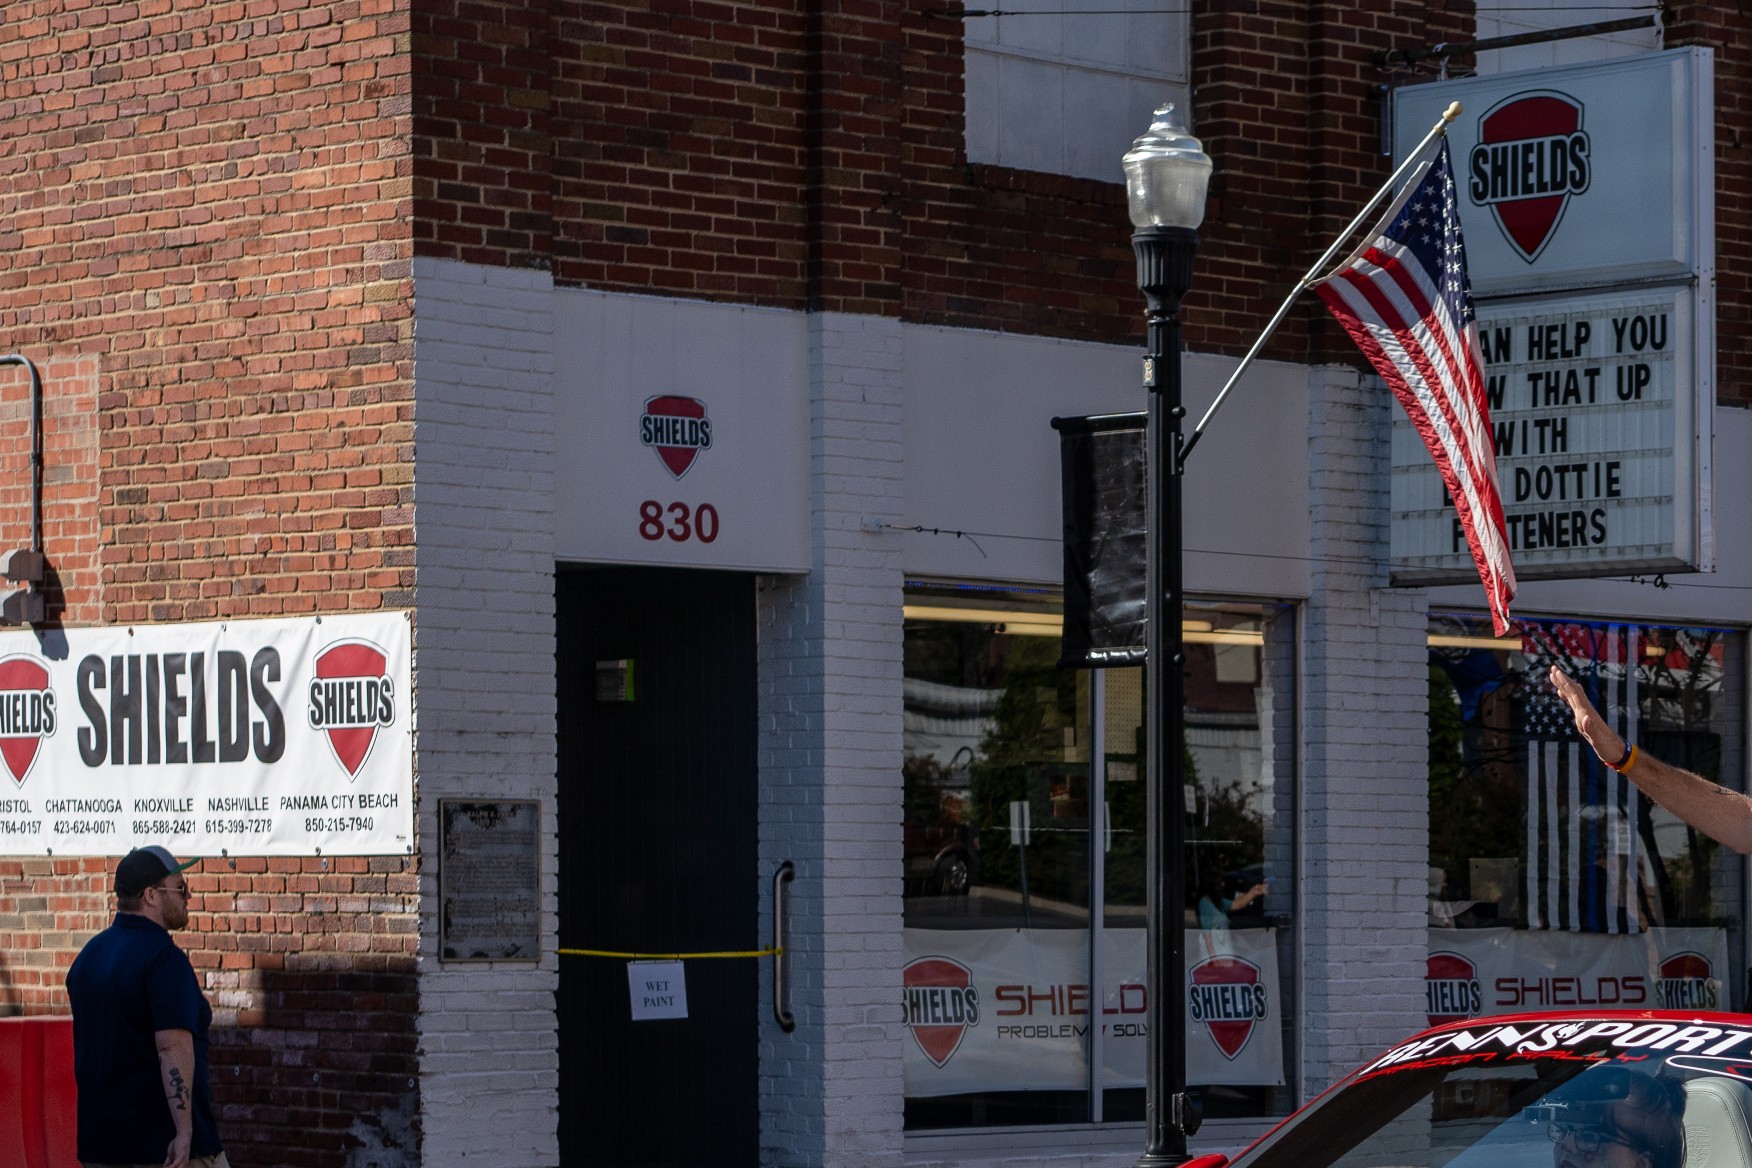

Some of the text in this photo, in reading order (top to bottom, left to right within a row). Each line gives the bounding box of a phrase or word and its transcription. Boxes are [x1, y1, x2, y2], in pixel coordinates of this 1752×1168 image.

[1472, 137, 1588, 200] SHIELDS
[1479, 314, 1668, 364] AN HELP YOU
[1528, 368, 1600, 407] THAT
[1617, 364, 1651, 400] UP
[642, 416, 711, 447] SHIELDS
[1491, 417, 1567, 457] WITH
[1515, 461, 1621, 502] DOTTIE
[639, 500, 719, 544] 830
[1453, 508, 1606, 553] FTENERS
[0, 692, 55, 735] IELDS
[77, 645, 286, 768] SHIELDS
[310, 679, 394, 726] SHIELDS
[45, 798, 123, 814] CHATTANOOGA
[134, 797, 194, 813] KNOXVILLE
[208, 796, 270, 812] NASHVILLE
[280, 795, 328, 810] PANAMA
[331, 794, 357, 810] CITY
[358, 793, 399, 809] BEACH
[0, 817, 374, 835] -764-0157 423-624-0071 865-588-2421 615-399-7278 850-215-7940
[643, 996, 674, 1007] PAINT
[646, 980, 669, 991] WET
[903, 986, 978, 1024] SHIELDS
[995, 983, 1147, 1016] SHIELD
[1190, 983, 1266, 1022] SHIELDS
[1425, 979, 1481, 1013] HIELDS
[1495, 975, 1646, 1006] SHIELDS
[1656, 978, 1718, 1011] SHIELDS
